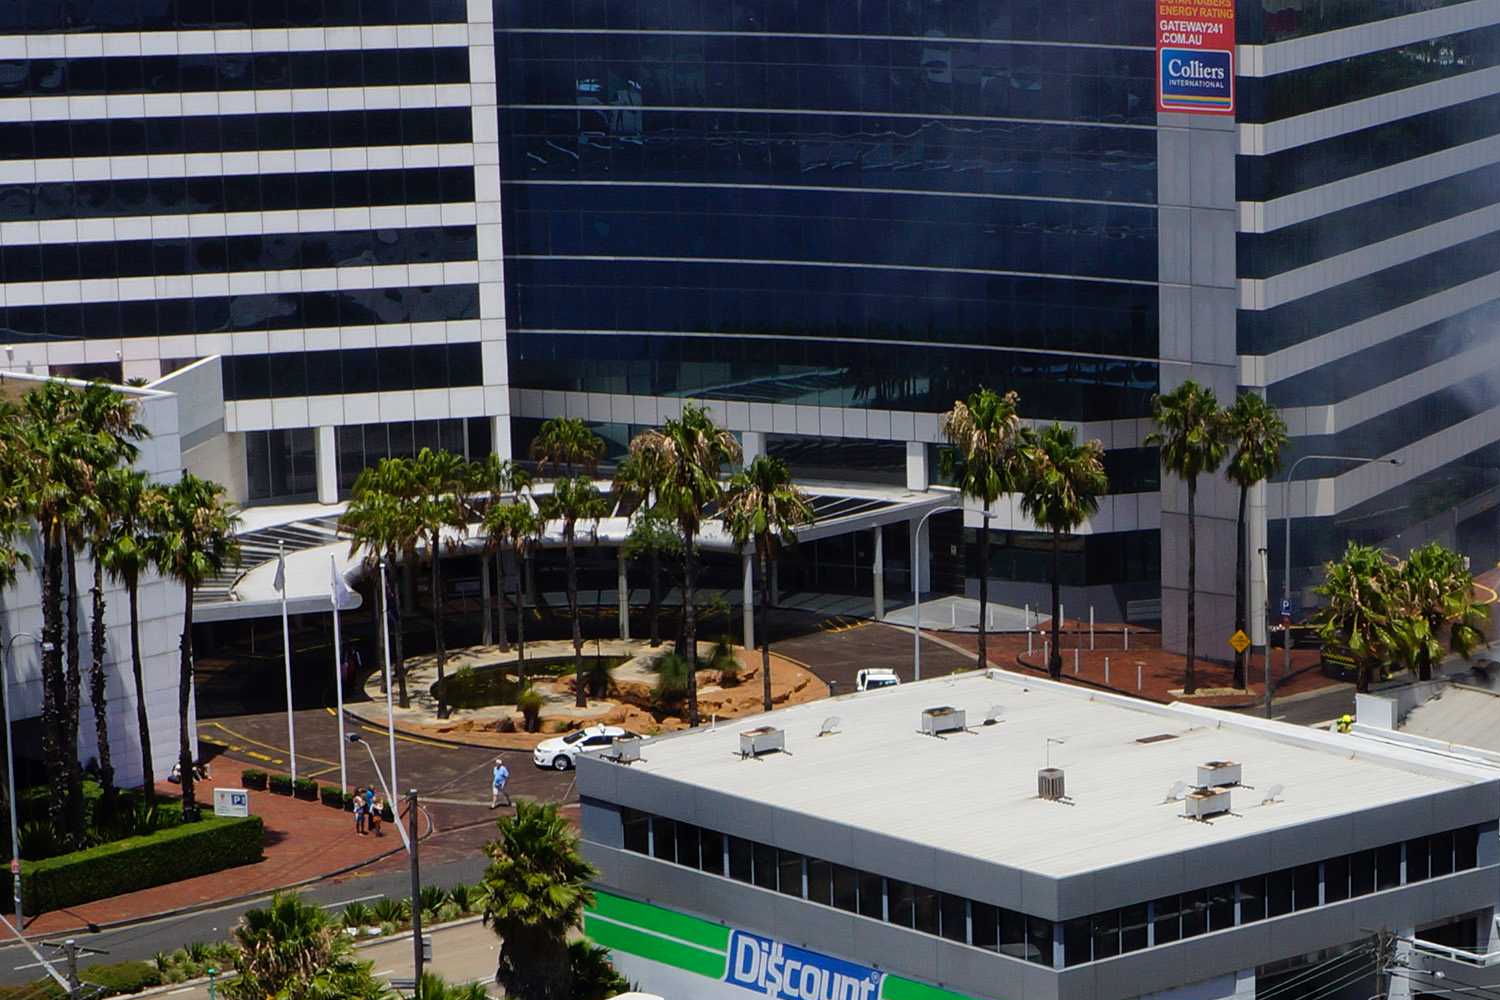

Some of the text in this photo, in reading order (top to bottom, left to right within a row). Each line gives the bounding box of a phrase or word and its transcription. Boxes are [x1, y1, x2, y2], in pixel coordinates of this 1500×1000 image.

[1160, 5, 1234, 18] ENERGY RATING
[1160, 20, 1223, 33] GATEWAY241
[1160, 33, 1202, 45] .COM.AU
[1168, 59, 1224, 79] Colliers
[1169, 79, 1224, 89] INTERNATIONAL
